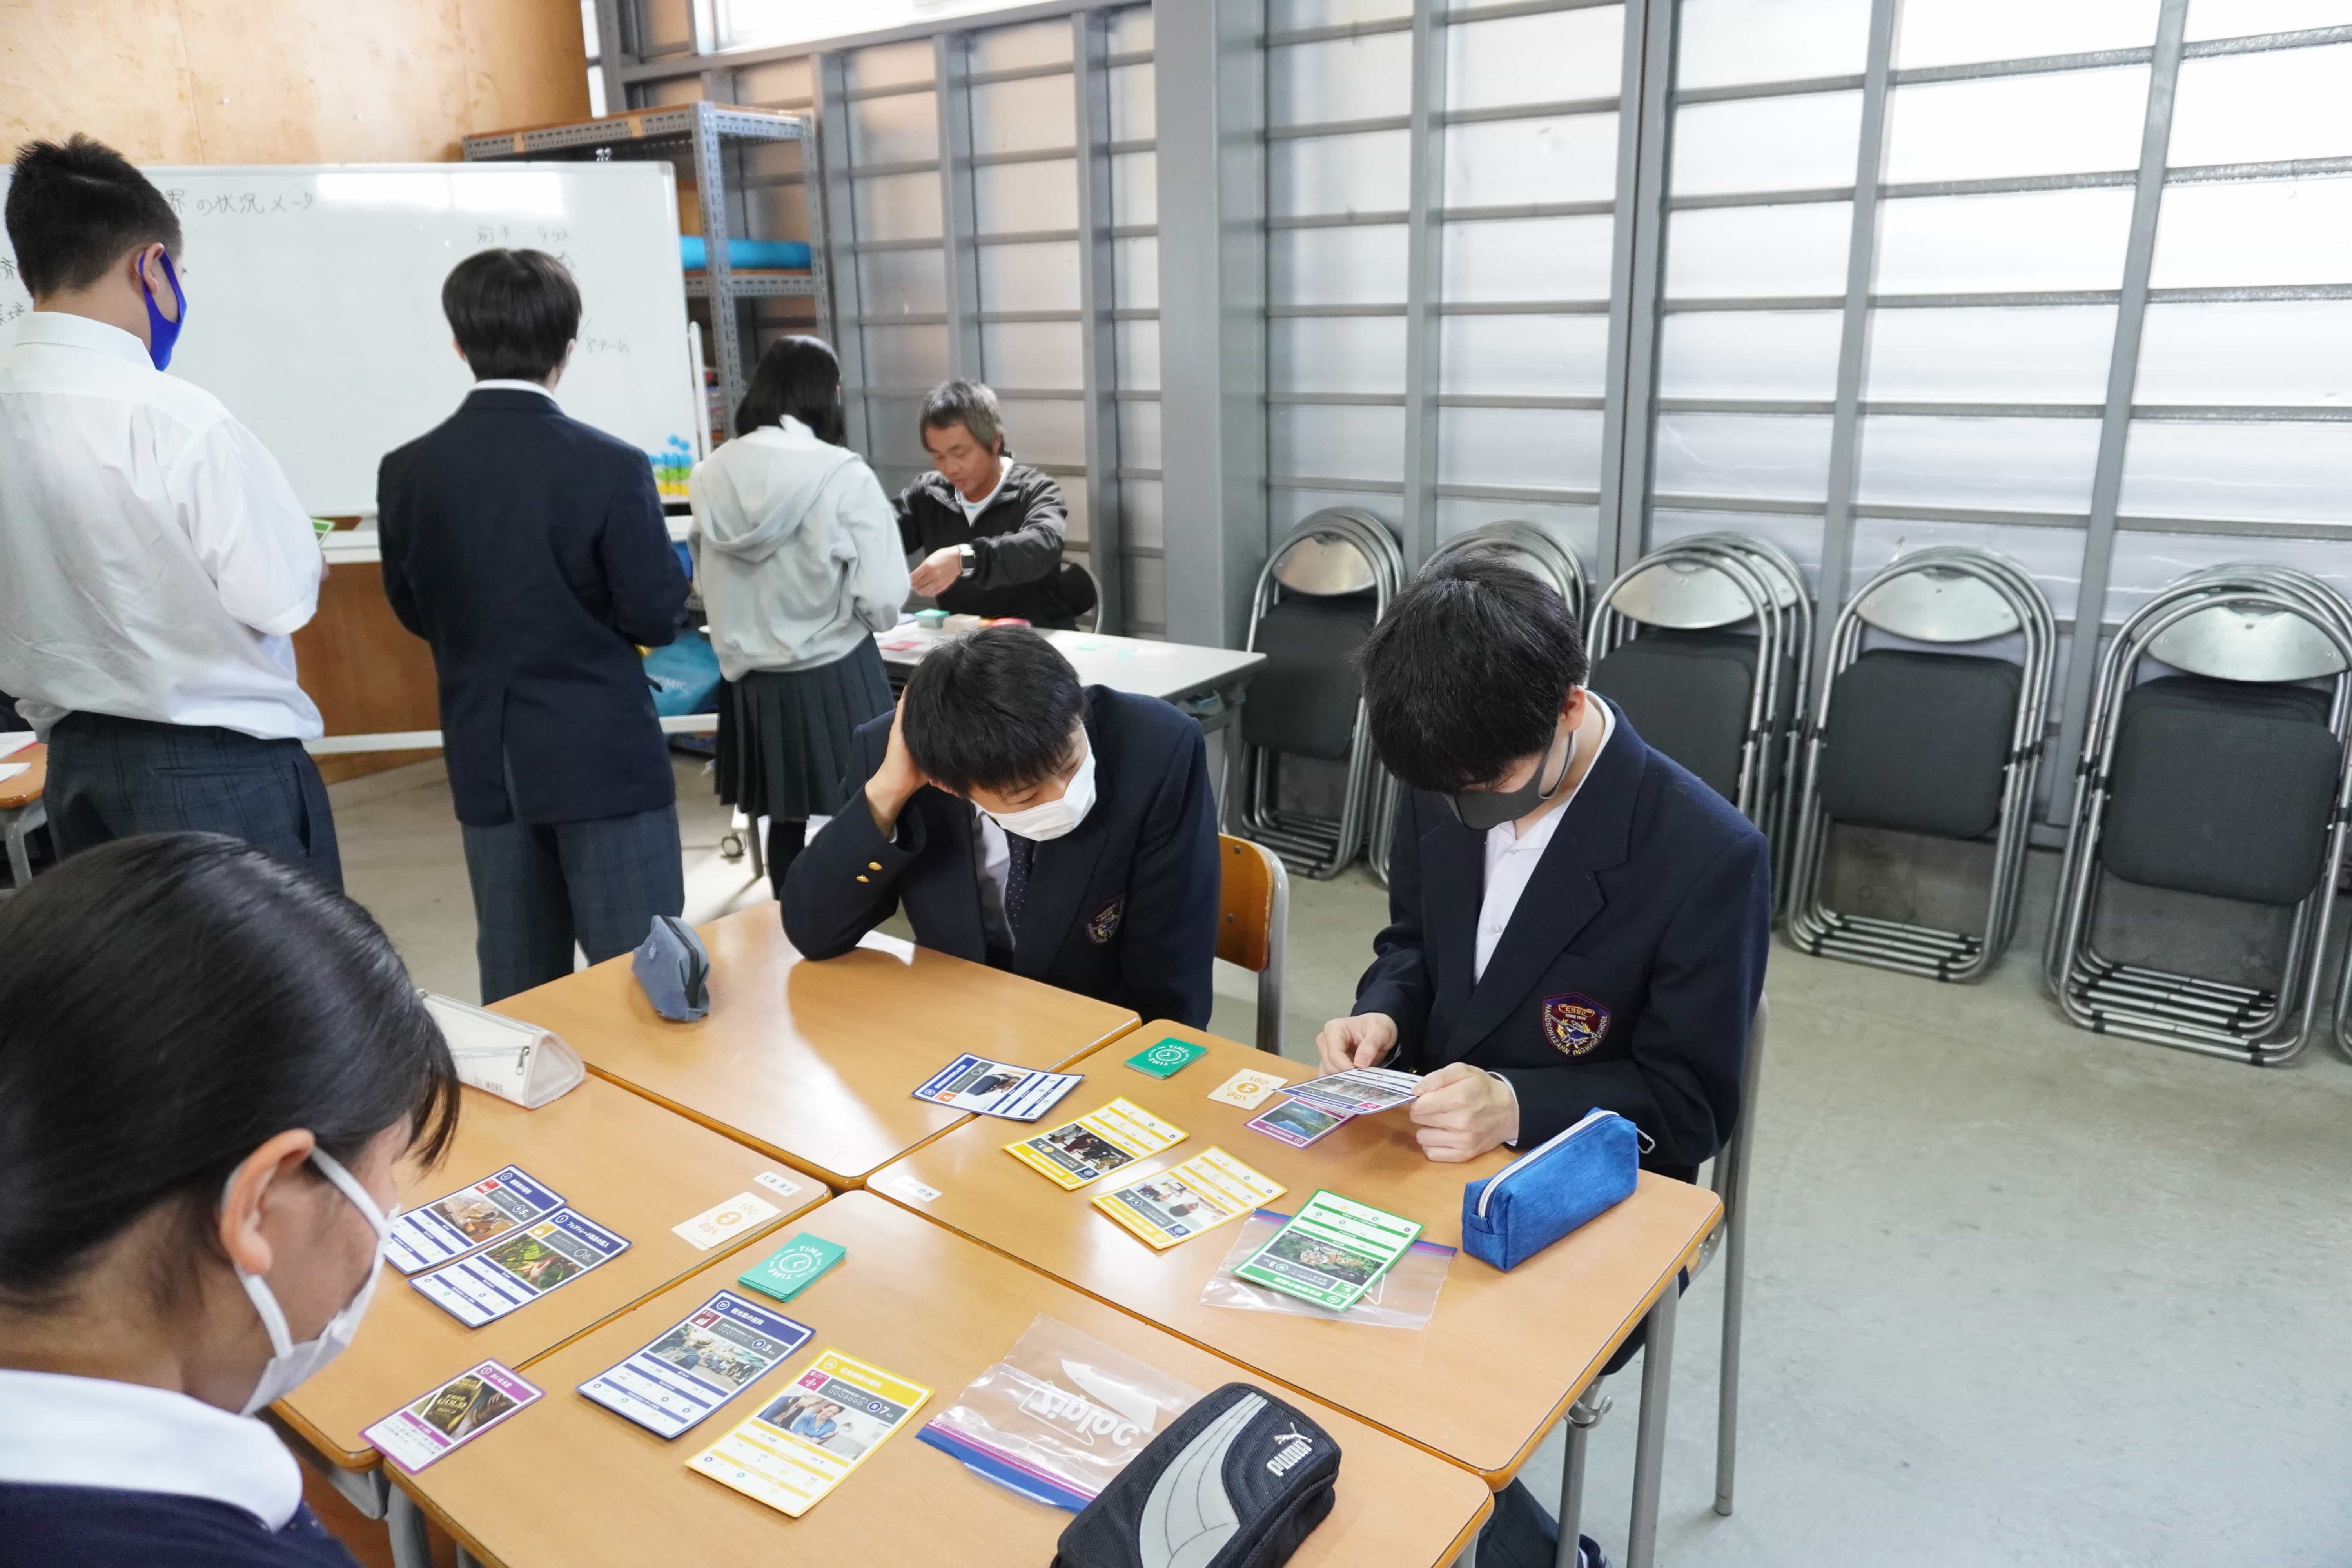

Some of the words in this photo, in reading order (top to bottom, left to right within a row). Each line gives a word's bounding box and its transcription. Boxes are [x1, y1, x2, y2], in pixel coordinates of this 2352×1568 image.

[1169, 1045, 1189, 1053] TIME
[1148, 1058, 1168, 1066] TIME
[1227, 1092, 1247, 1100] 100
[740, 1203, 759, 1214] 100
[699, 1222, 719, 1234] 100
[800, 1246, 823, 1257] TIME
[768, 1268, 791, 1279] TIME
[1267, 1439, 1312, 1477] PUMA
